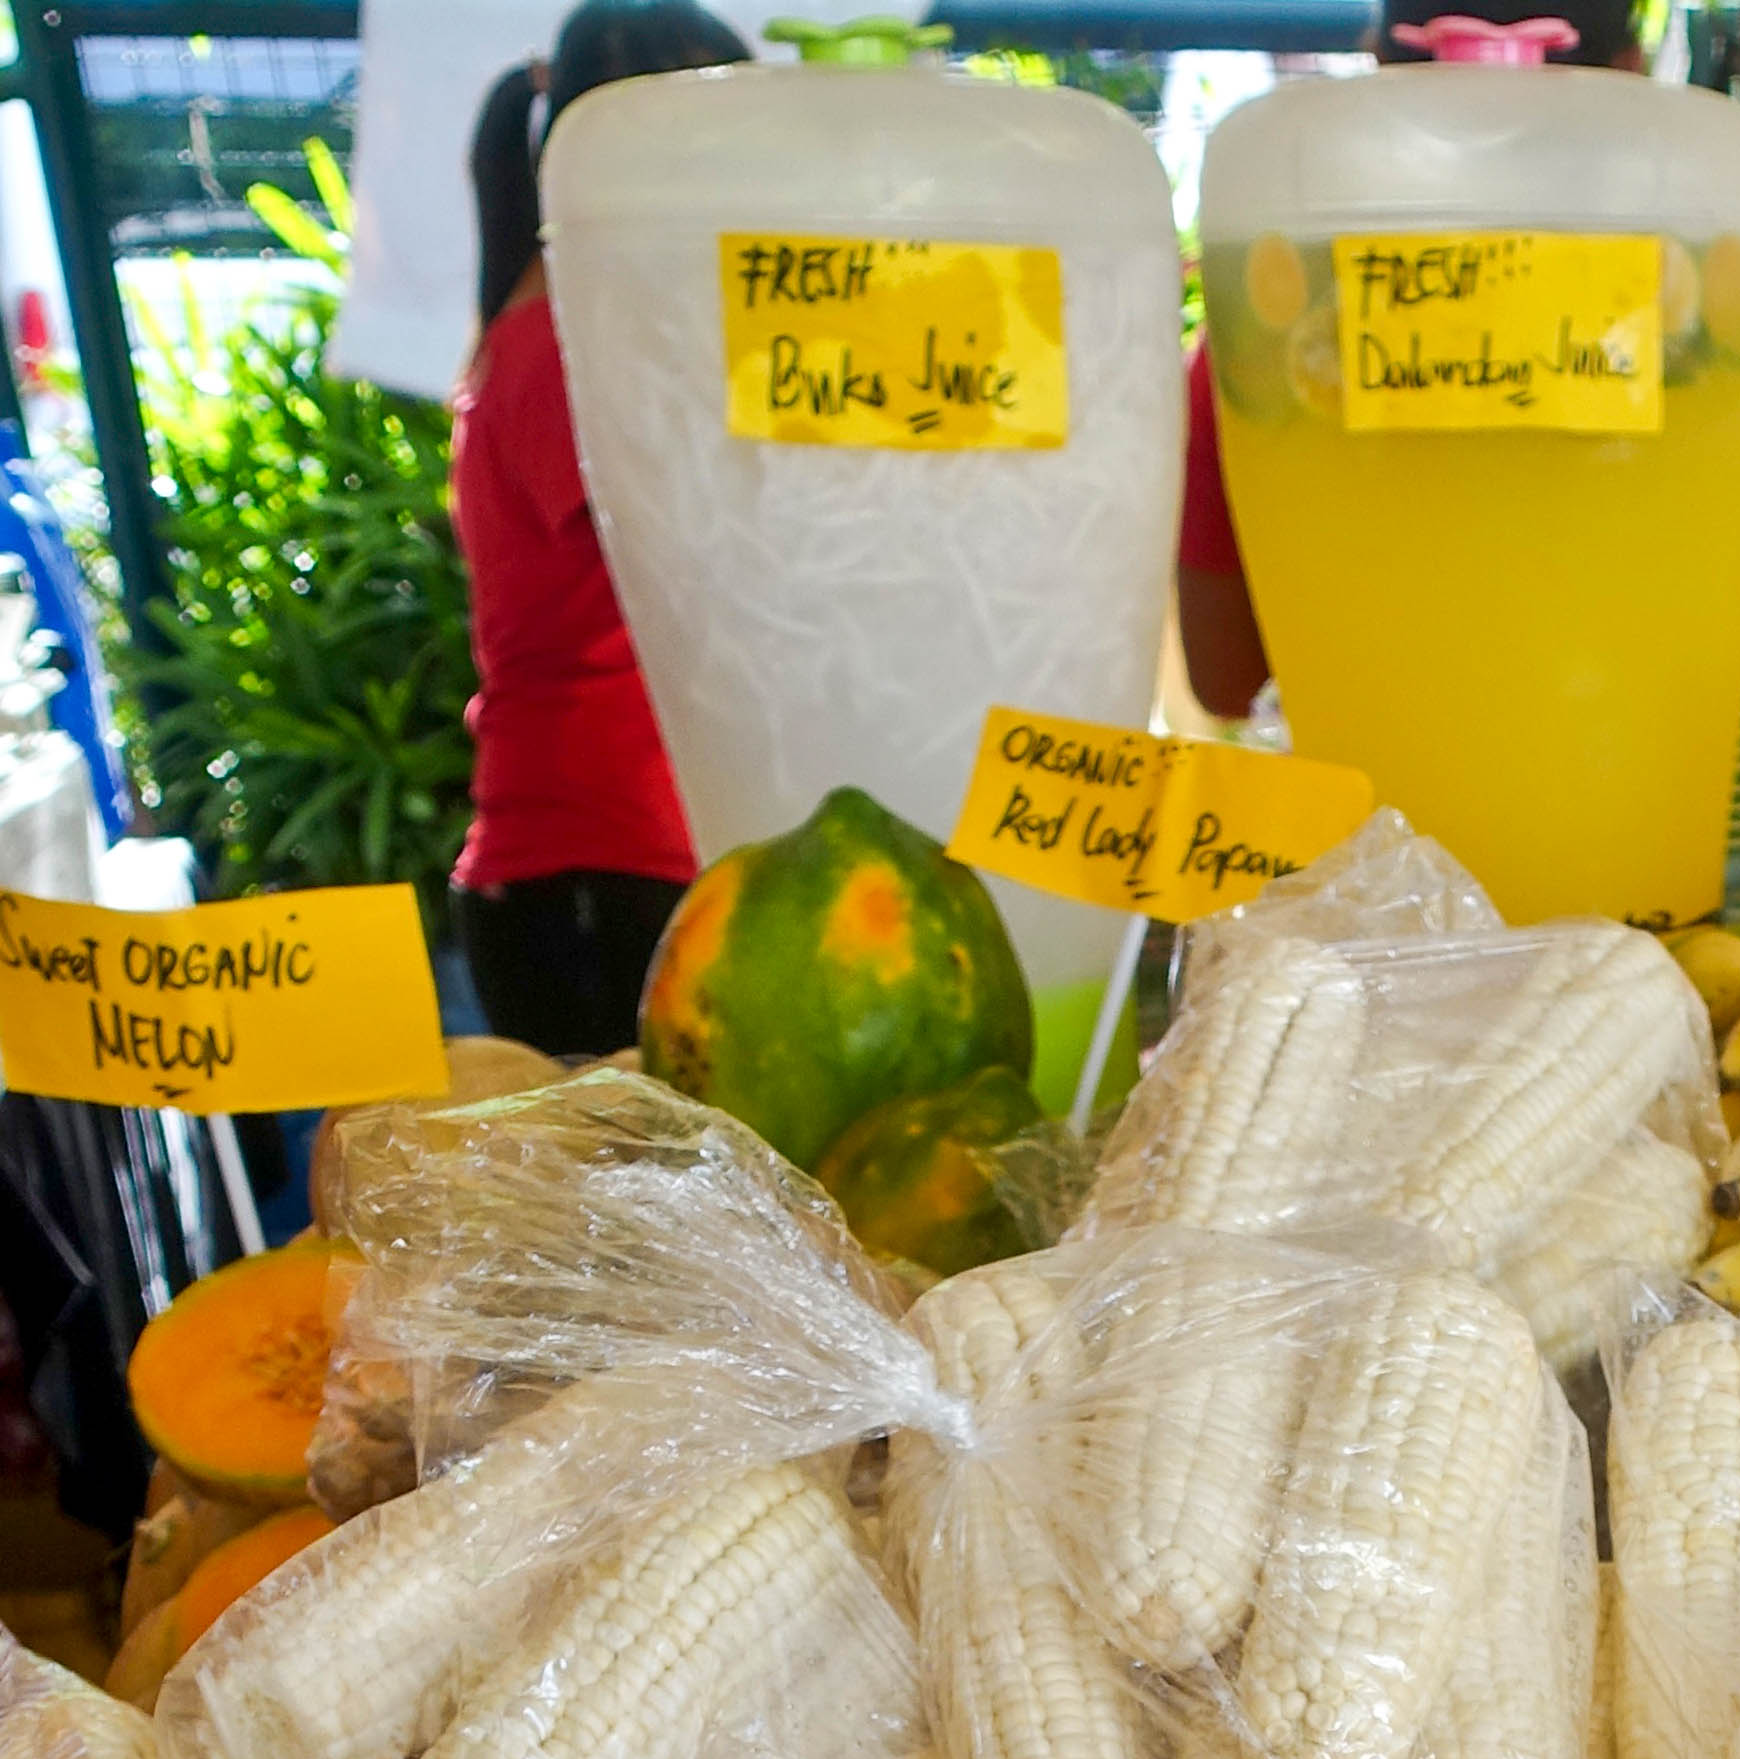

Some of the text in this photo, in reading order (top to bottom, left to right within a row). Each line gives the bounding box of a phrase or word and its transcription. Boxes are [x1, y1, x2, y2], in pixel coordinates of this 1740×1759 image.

[907, 325, 1018, 410] Juice
[1002, 725, 1145, 788] ORGANIC
[992, 785, 1077, 850] Red
[1081, 807, 1156, 875] Lady
[122, 914, 315, 991] ORGANIC
[88, 997, 236, 1079] MELON
